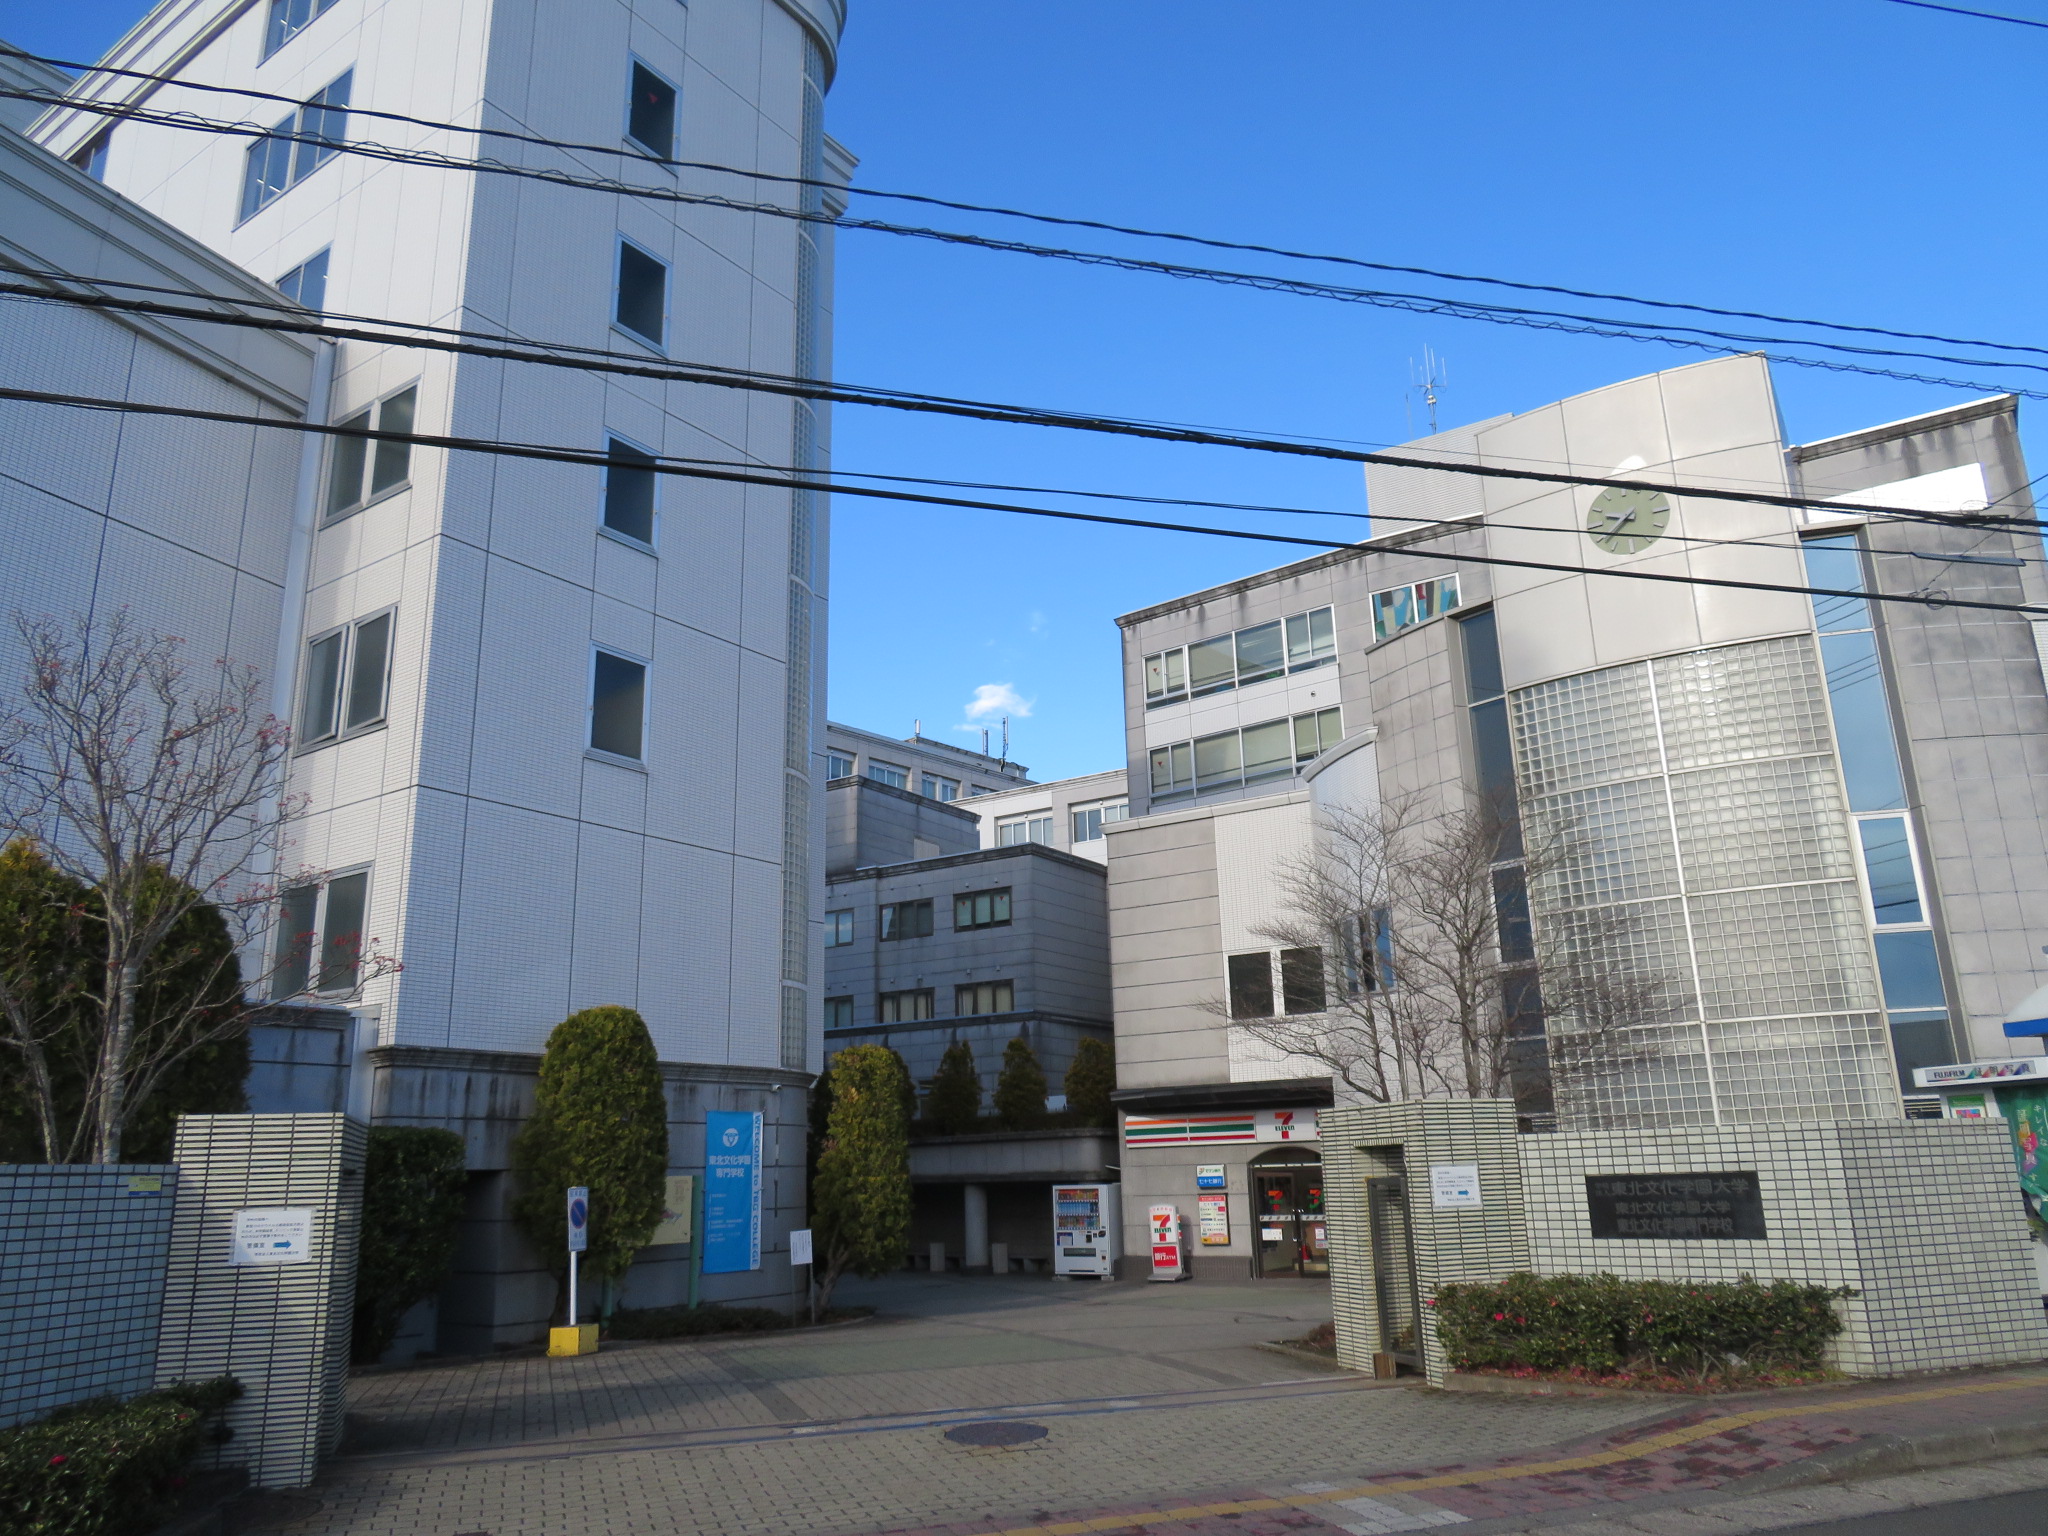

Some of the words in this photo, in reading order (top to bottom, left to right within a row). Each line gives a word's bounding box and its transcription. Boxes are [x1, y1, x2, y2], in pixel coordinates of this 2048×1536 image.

[1934, 1069, 1965, 1079] FUJIFILM
[1274, 1112, 1293, 1139] 7
[753, 1115, 761, 1172] WELCOME
[2017, 1109, 2038, 1166] 証明写真
[709, 1155, 752, 1166] 東北文化学園
[716, 1168, 746, 1179] 専門学校
[1611, 1178, 1749, 1197] 東北文化学園大学
[1615, 1200, 1731, 1216] 東北文化学園大学
[1153, 1214, 1171, 1242] 7
[1616, 1217, 1735, 1235] 東北文化学園専門学校
[750, 1215, 760, 1267] COLLEGE
